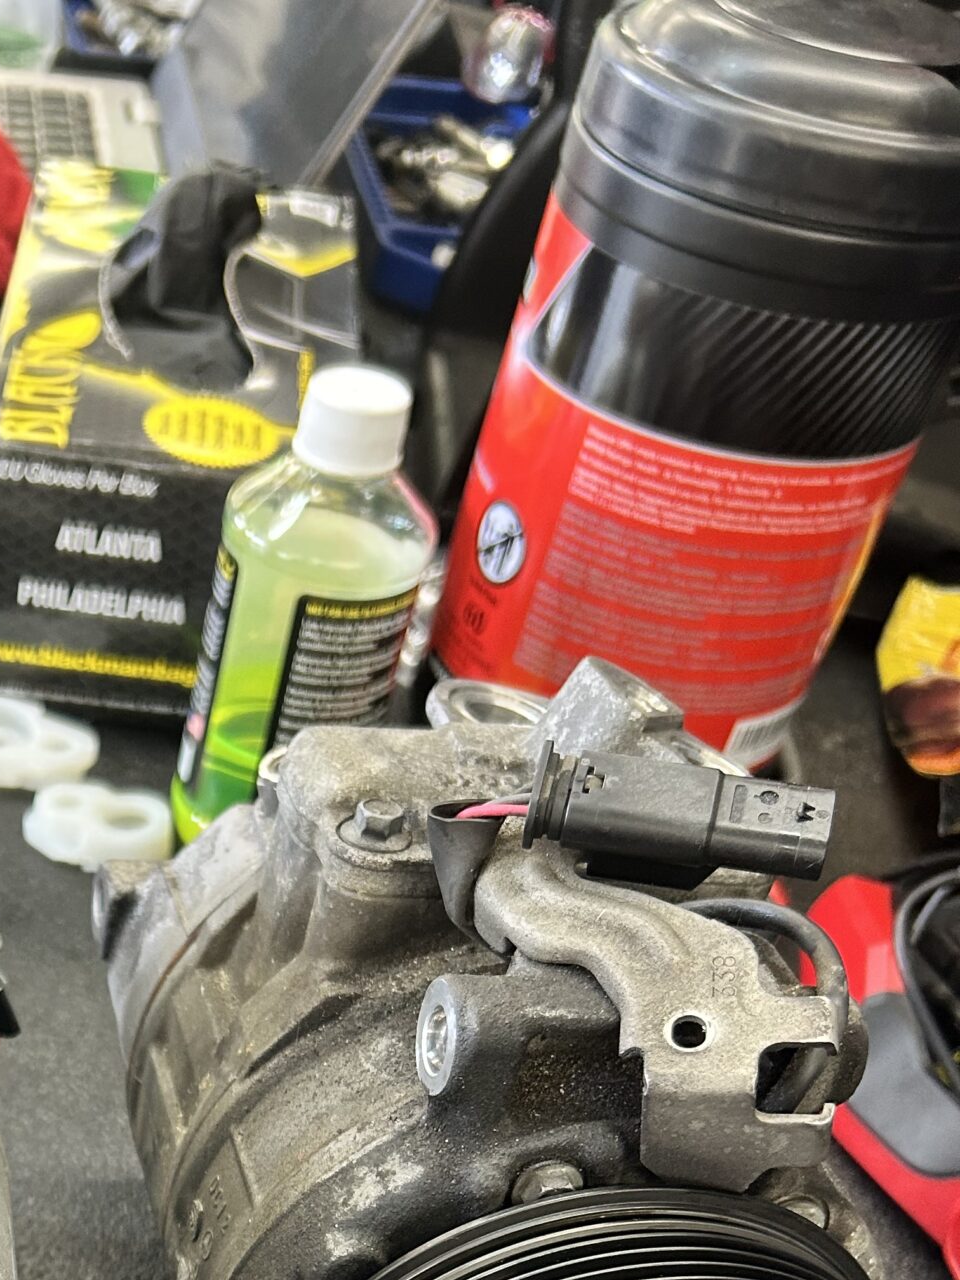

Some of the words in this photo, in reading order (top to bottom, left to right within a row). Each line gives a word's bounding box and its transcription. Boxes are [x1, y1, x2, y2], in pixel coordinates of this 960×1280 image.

[55, 519, 162, 563] ATLANTA
[17, 576, 186, 625] PHILADELPHIA
[711, 955, 737, 998] 338
